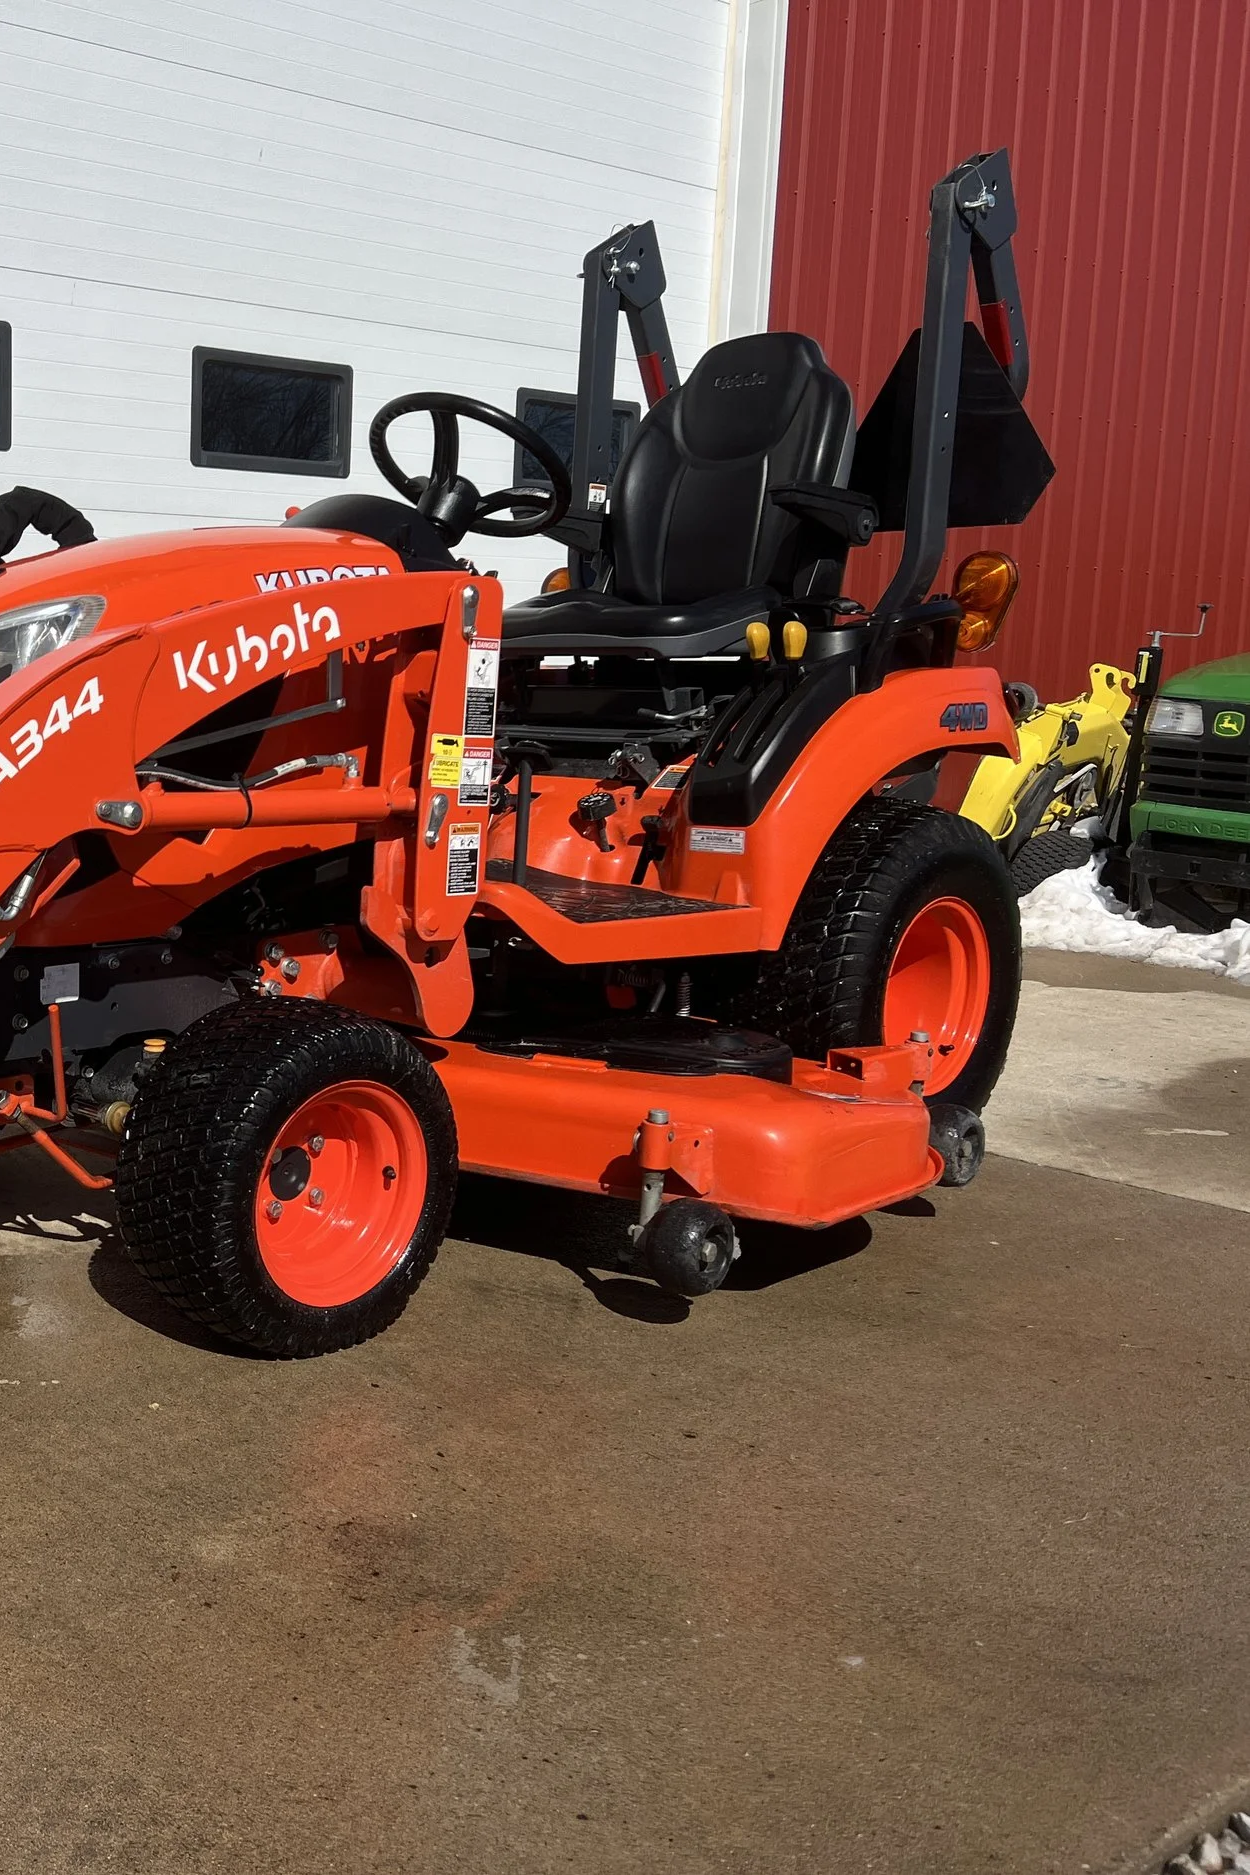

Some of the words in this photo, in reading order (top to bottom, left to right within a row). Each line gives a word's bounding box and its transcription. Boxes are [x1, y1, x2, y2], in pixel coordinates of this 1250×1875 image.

[172, 601, 342, 694] Kubota
[939, 701, 988, 733] 4WD
[469, 749, 491, 759] DANGER
[1155, 815, 1204, 835] JOHN
[1209, 822, 1250, 841] DEE
